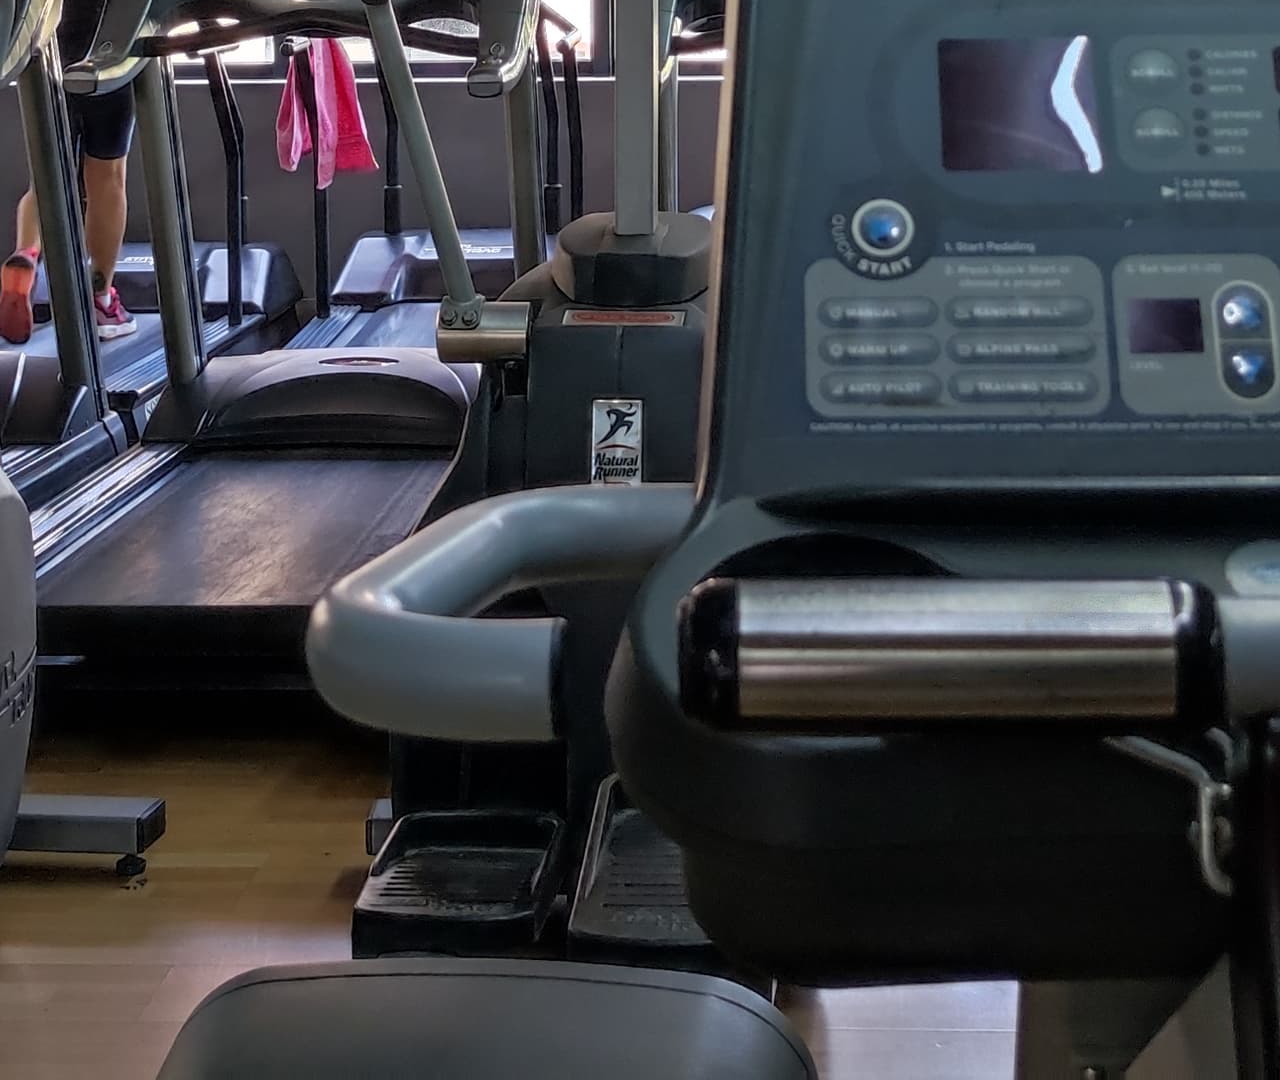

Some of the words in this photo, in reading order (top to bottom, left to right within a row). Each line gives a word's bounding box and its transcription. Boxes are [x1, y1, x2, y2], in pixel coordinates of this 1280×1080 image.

[832, 214, 855, 262] QUICK
[857, 255, 913, 276] START
[594, 452, 640, 466] Natural
[593, 466, 639, 480] Runner
